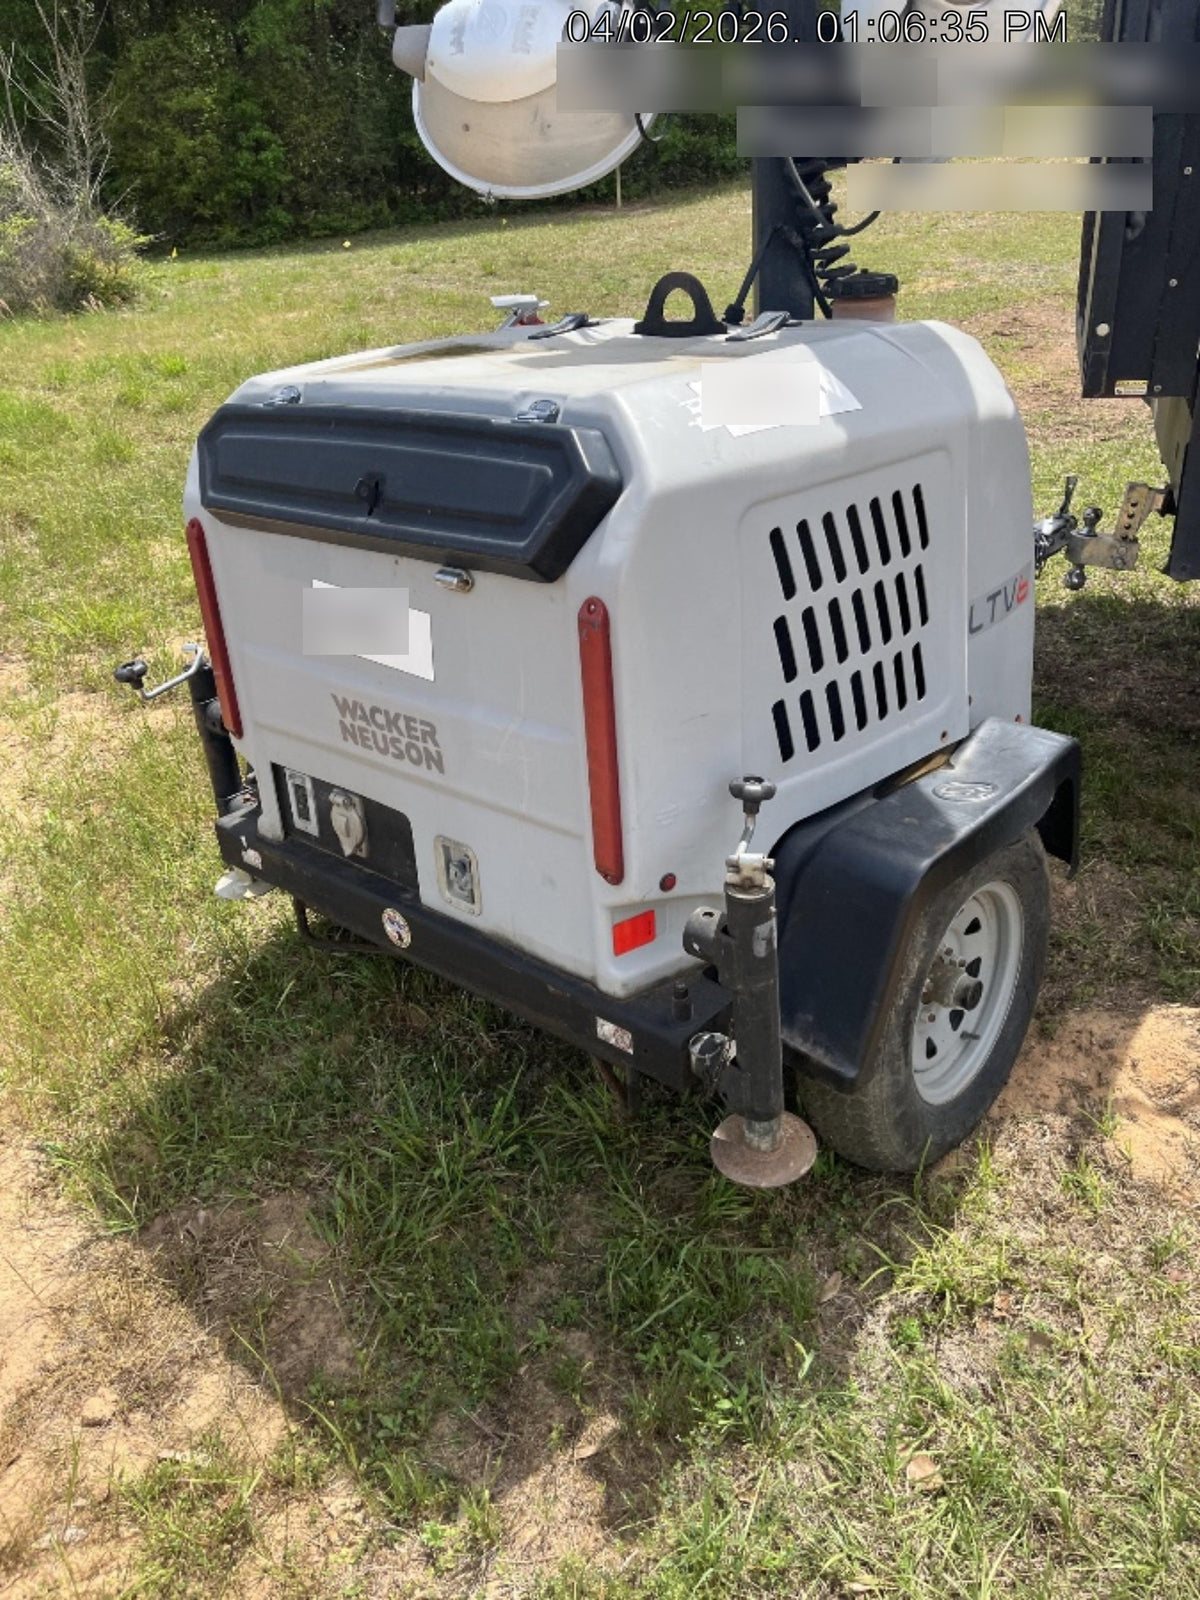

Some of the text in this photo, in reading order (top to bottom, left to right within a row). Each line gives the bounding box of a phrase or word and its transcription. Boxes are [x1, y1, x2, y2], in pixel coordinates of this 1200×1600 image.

[968, 574, 1029, 634] LTV6
[330, 693, 440, 748] WACKER
[339, 719, 445, 774] NEUSON
